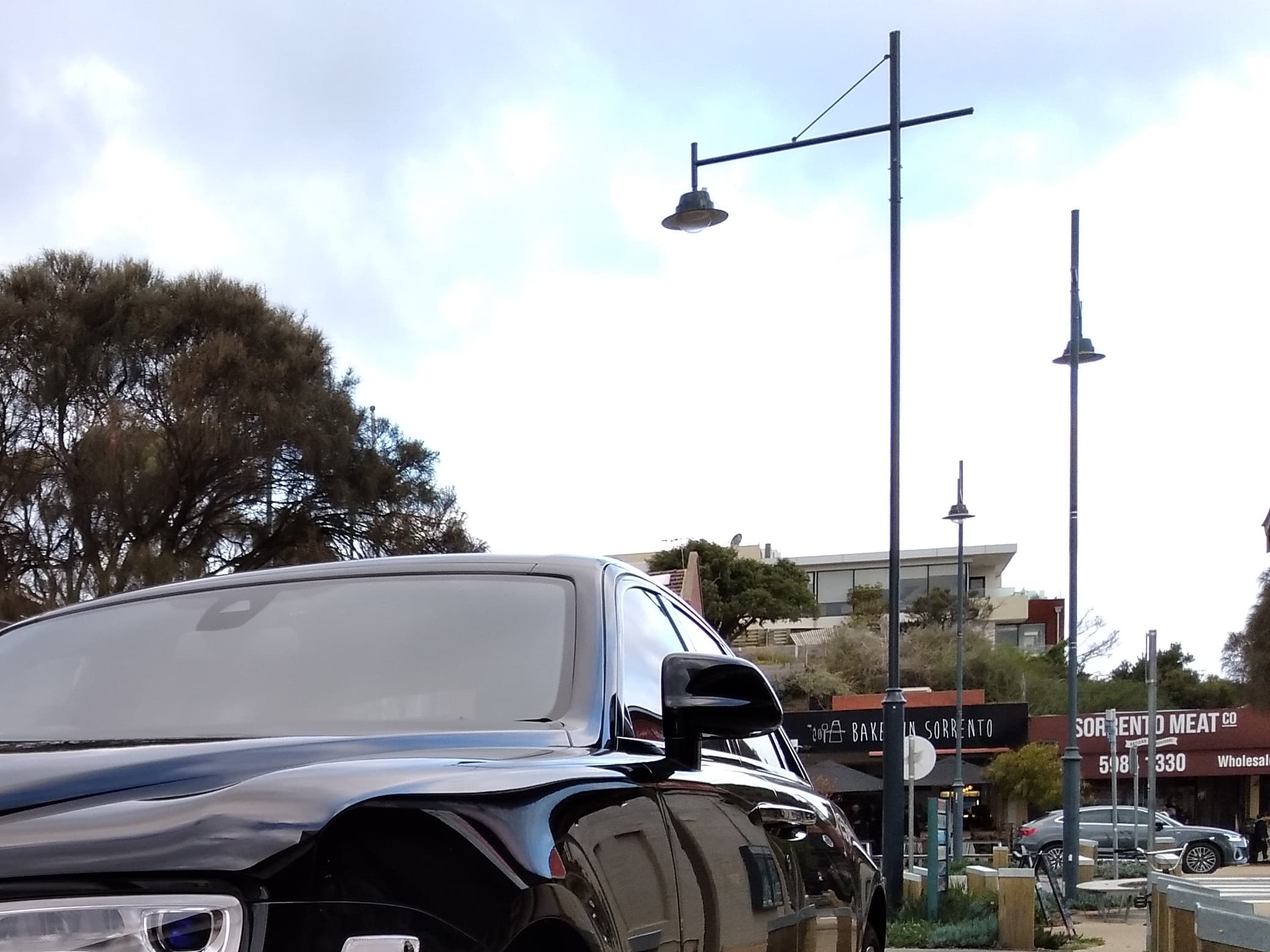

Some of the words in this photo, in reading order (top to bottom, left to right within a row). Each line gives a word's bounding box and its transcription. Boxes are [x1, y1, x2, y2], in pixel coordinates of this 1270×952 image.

[852, 721, 884, 742] BAKE
[1169, 712, 1219, 734] MEAT
[1222, 711, 1237, 726] CO
[1218, 754, 1270, 768] Wholesal
